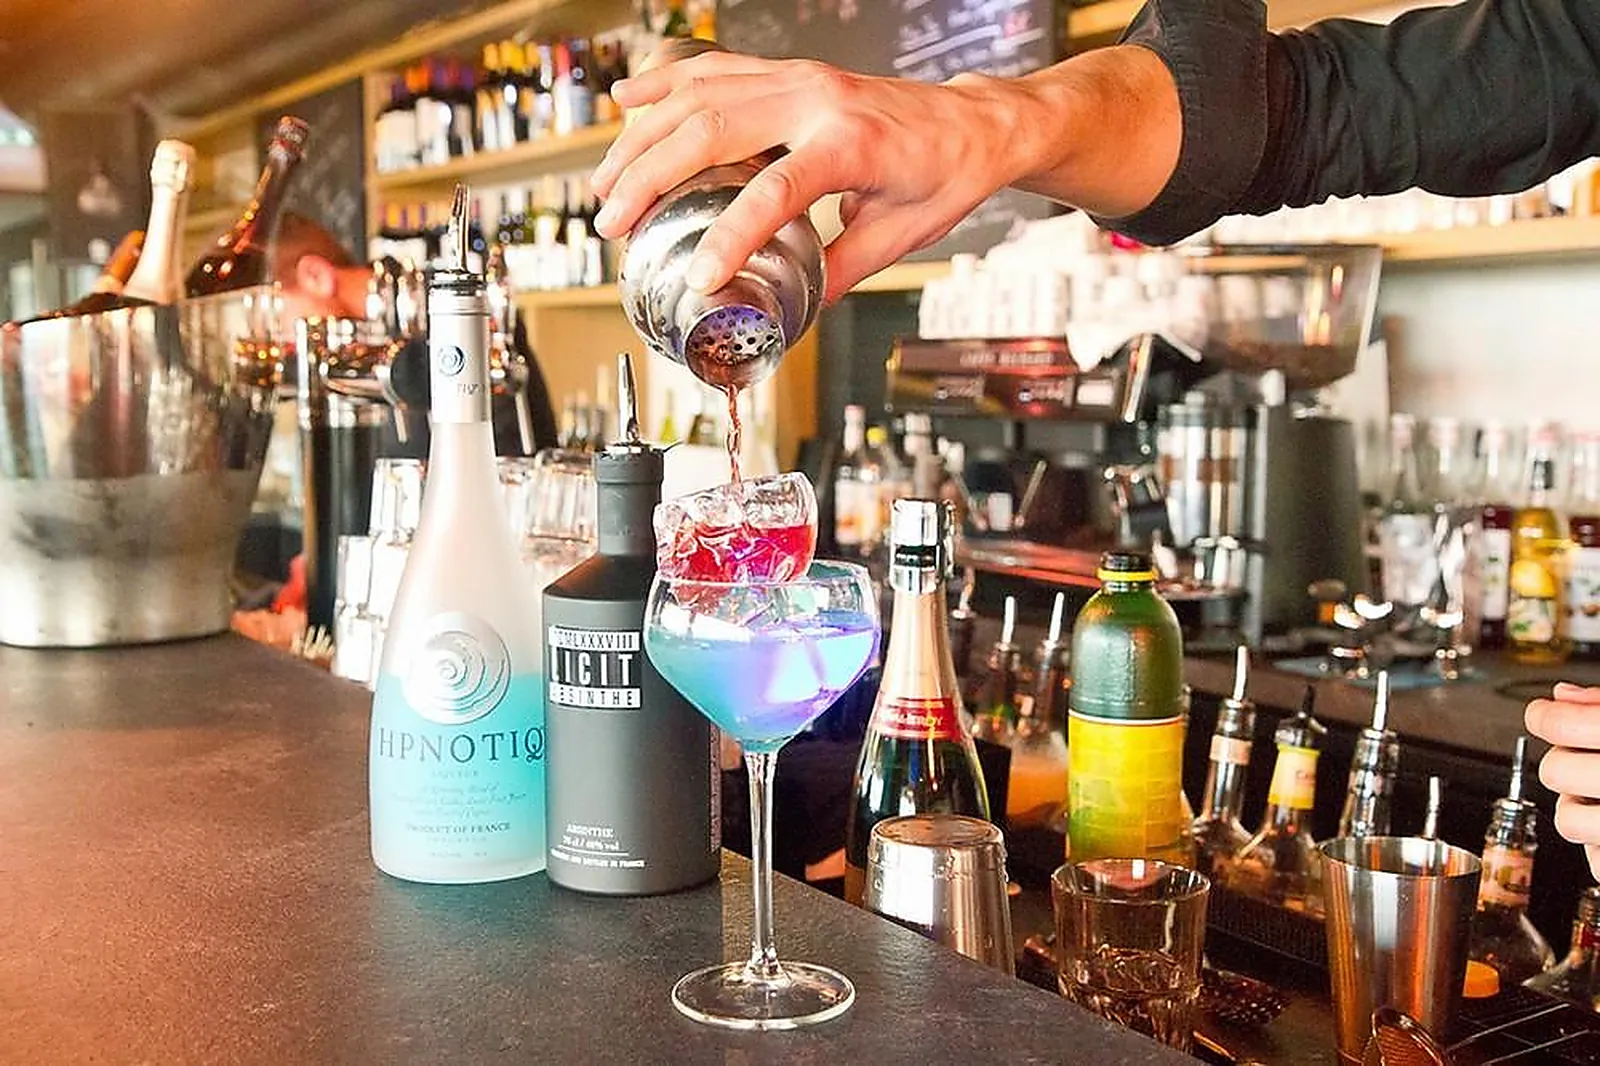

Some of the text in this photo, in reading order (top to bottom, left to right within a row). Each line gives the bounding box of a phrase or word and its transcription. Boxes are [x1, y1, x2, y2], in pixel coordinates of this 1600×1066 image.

[379, 727, 544, 763] HPNOTIQ
[453, 823, 467, 834] OF
[471, 822, 511, 834] FRANCE
